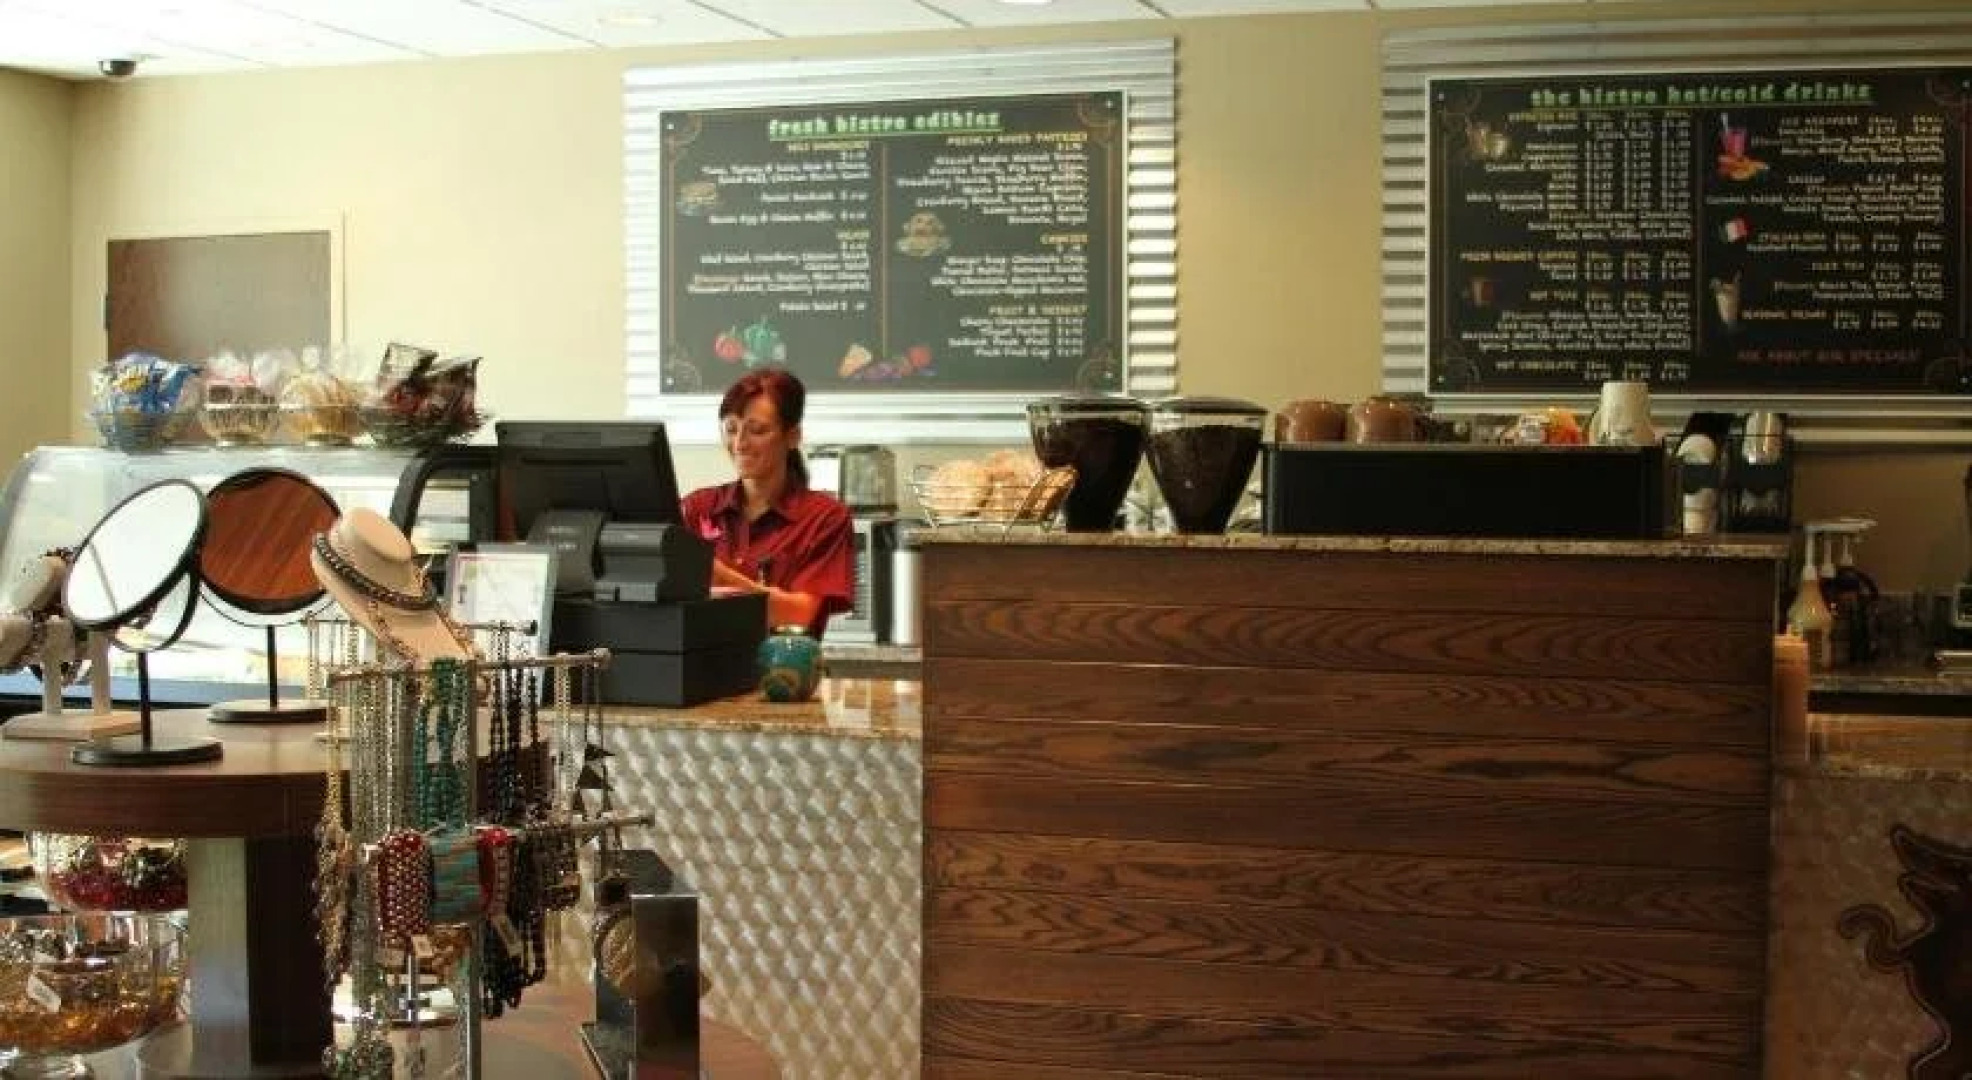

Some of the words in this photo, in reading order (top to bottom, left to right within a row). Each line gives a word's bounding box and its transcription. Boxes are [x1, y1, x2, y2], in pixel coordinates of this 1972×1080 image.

[1532, 89, 1571, 106] the
[1580, 88, 1656, 104] bistro
[1667, 84, 1774, 103] hot/cold
[1783, 83, 1872, 101] drinks
[770, 118, 829, 136] fresh
[836, 114, 906, 134] bistro
[914, 112, 1000, 130] edibles
